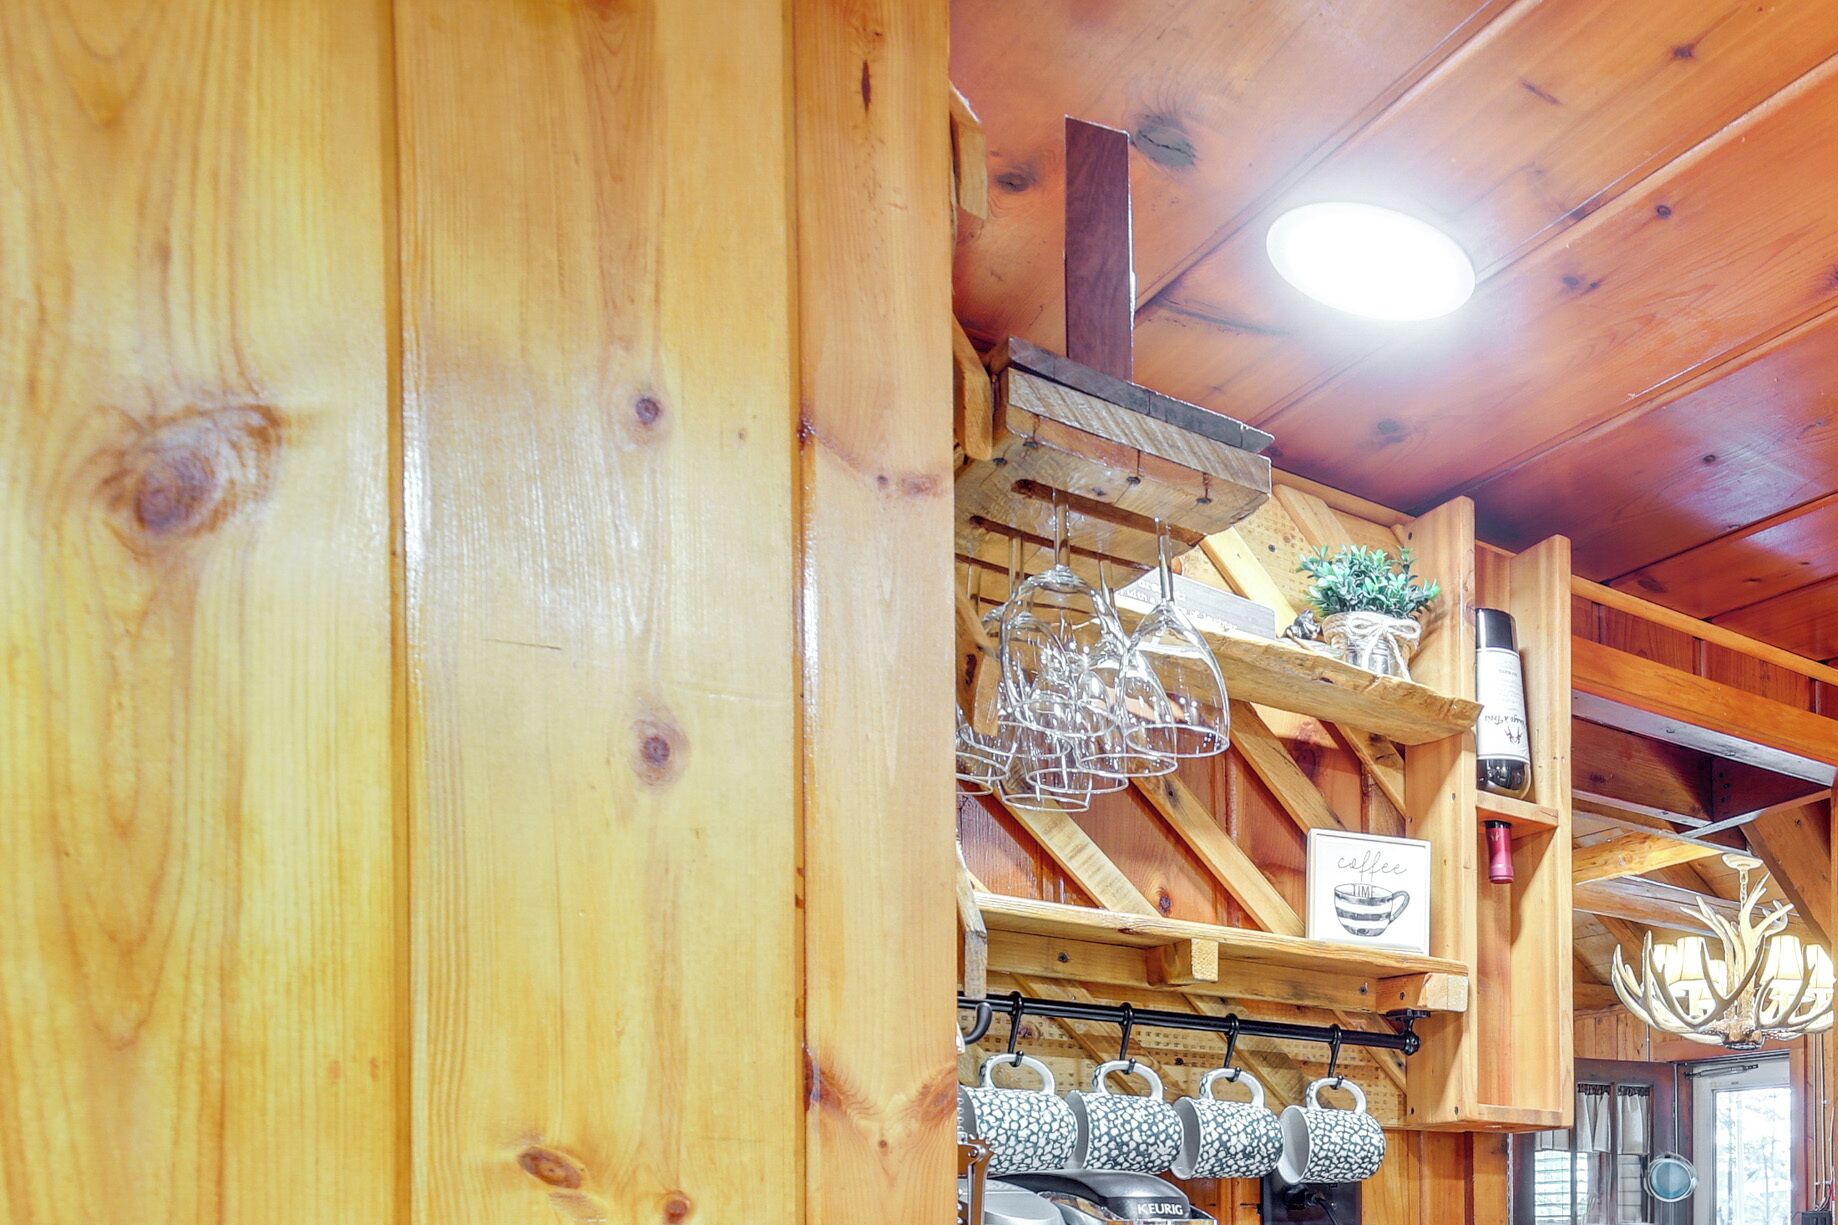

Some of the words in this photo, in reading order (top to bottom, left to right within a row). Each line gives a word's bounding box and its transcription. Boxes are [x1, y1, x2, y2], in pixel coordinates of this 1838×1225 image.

[1337, 849, 1408, 883] coffee
[1351, 883, 1376, 899] TIME
[1137, 1202, 1184, 1216] KEURIG
